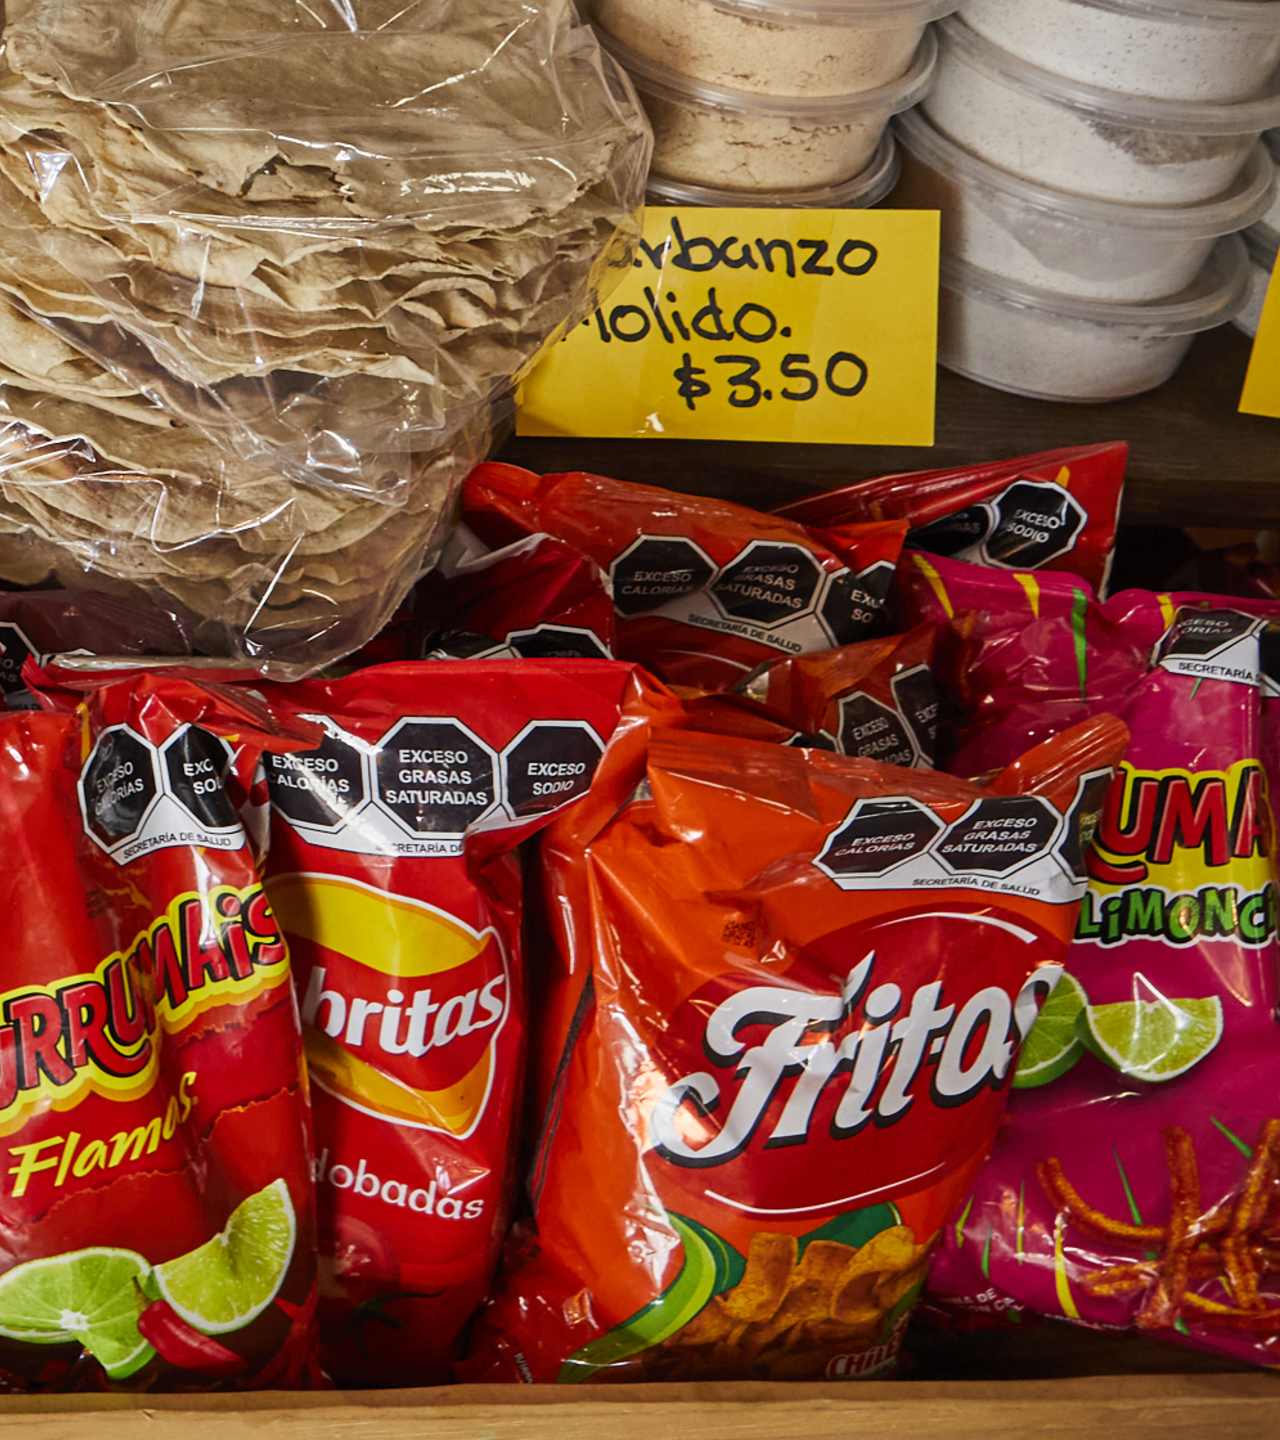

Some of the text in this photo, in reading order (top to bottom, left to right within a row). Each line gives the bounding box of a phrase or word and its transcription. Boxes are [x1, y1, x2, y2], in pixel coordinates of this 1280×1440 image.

[633, 216, 878, 259] rbanzo
[673, 352, 868, 410] $3.50
[633, 570, 693, 583] EXCESO
[750, 628, 765, 641] DE
[767, 633, 802, 653] SALUD
[272, 755, 339, 773] EXCESO
[399, 749, 469, 765] EXCESO
[97, 761, 134, 793] EXCESO
[399, 769, 472, 785] GRASAS
[527, 762, 586, 777] EXCESO
[532, 780, 575, 796] SODIO
[386, 789, 488, 806] SATURADAS
[973, 817, 1038, 830] EXCESO
[179, 832, 193, 841] DE
[198, 834, 231, 846] SALUD
[851, 832, 915, 846] EXCESO
[963, 829, 1031, 841] GRASAS
[941, 842, 1038, 854] SATURADAS
[913, 876, 1040, 896] SECRETARÍA DE SALUD
